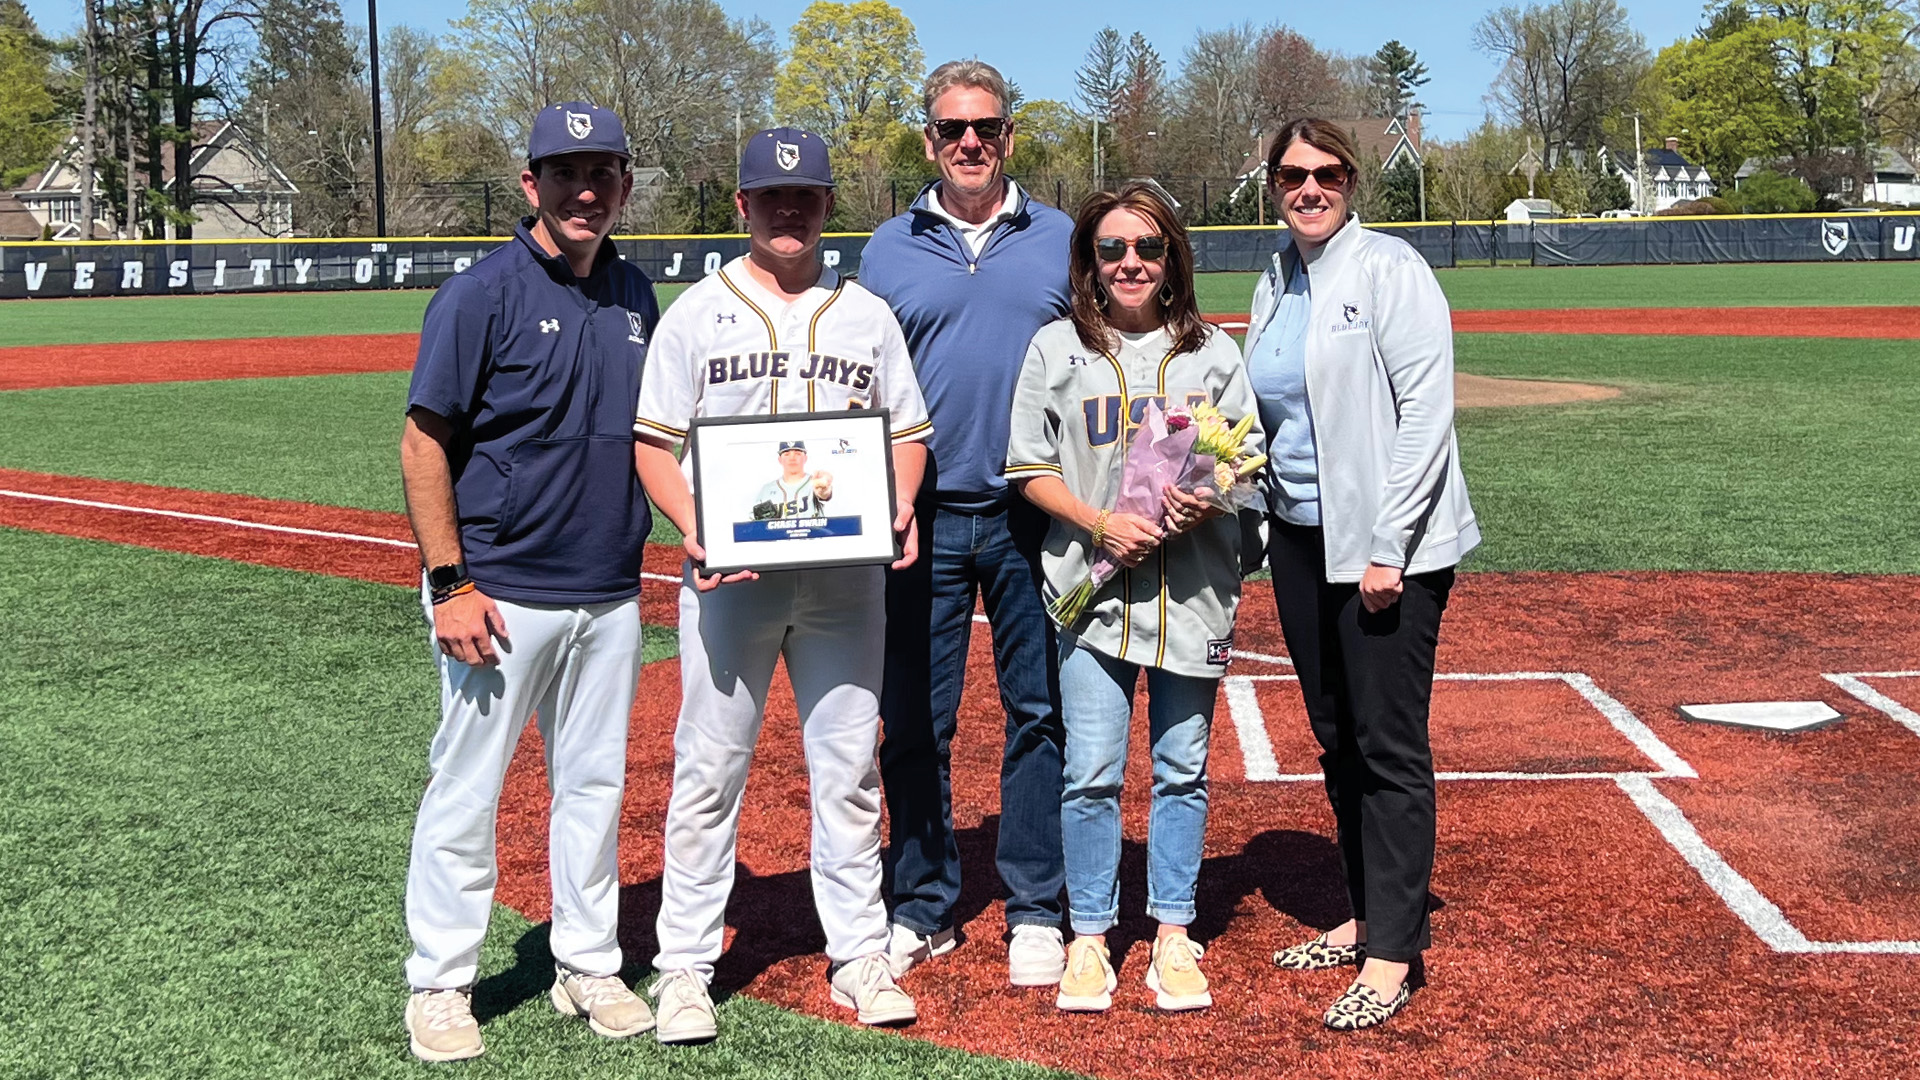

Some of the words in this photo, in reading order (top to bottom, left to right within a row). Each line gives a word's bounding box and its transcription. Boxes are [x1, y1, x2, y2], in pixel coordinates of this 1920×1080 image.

[371, 243, 388, 252] 350
[24, 257, 313, 291] VERSITY
[355, 257, 413, 284] OF
[708, 352, 790, 385] BLUE
[800, 351, 875, 391] JAYS
